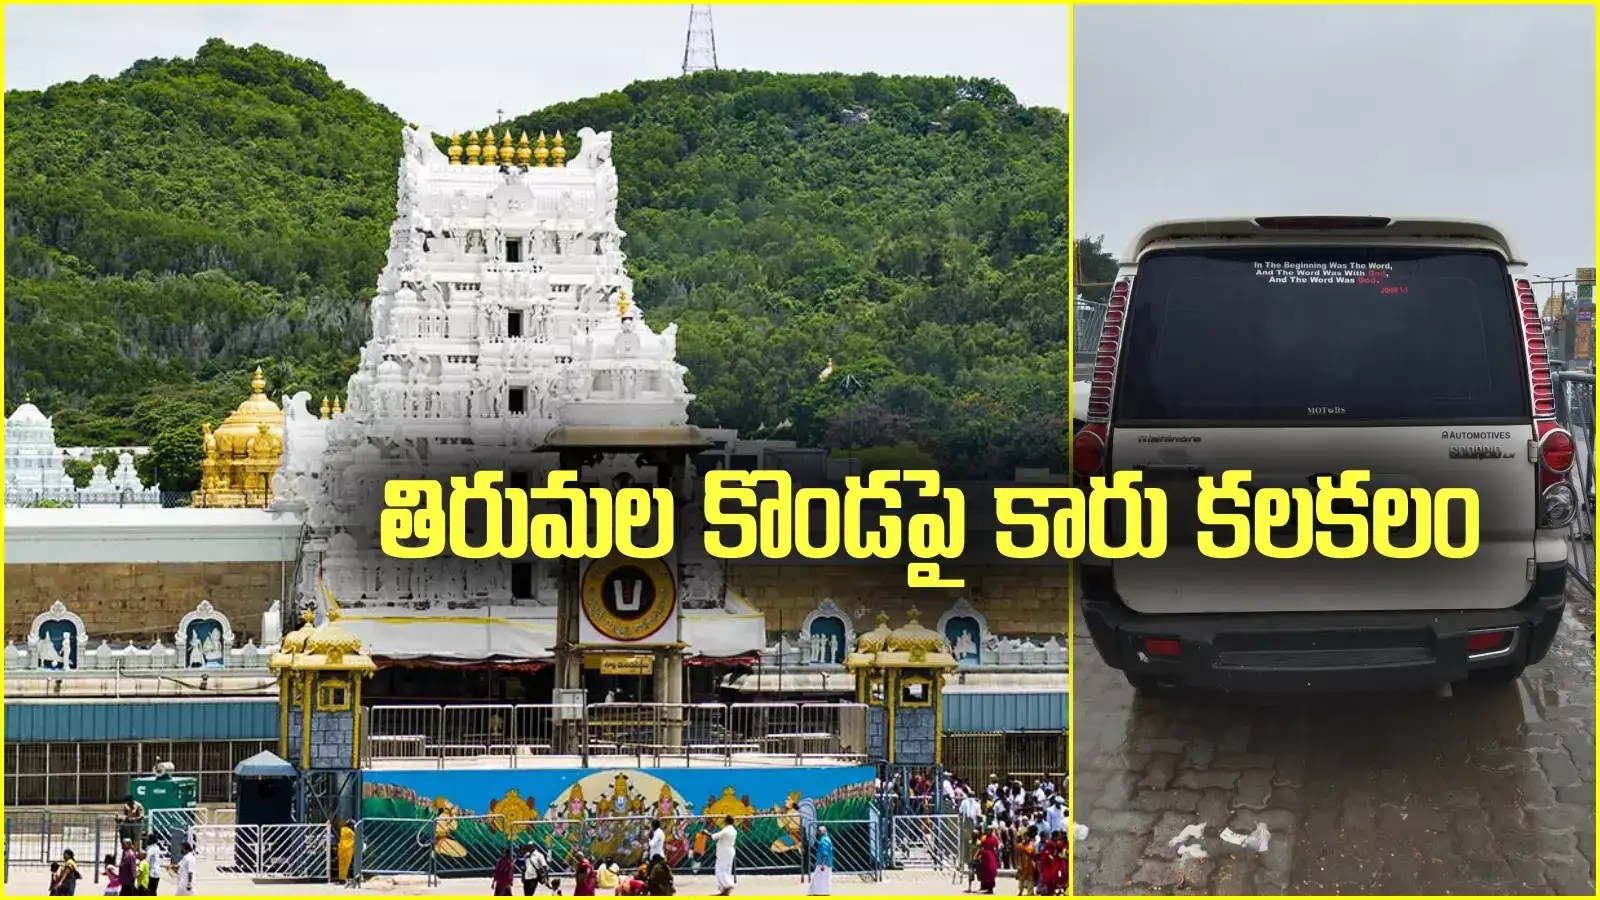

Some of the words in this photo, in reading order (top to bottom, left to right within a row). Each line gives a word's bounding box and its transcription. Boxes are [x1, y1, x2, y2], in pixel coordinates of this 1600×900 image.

[1253, 261, 1263, 269] In
[1265, 261, 1281, 269] The
[1284, 261, 1327, 270] Beginning
[1329, 261, 1347, 269] Was
[1350, 261, 1366, 269] The
[1368, 262, 1393, 270] Word,
[1367, 269, 1389, 278] God,
[1336, 276, 1355, 284] Was
[1357, 276, 1380, 284] God.
[1380, 286, 1398, 294] JOHN
